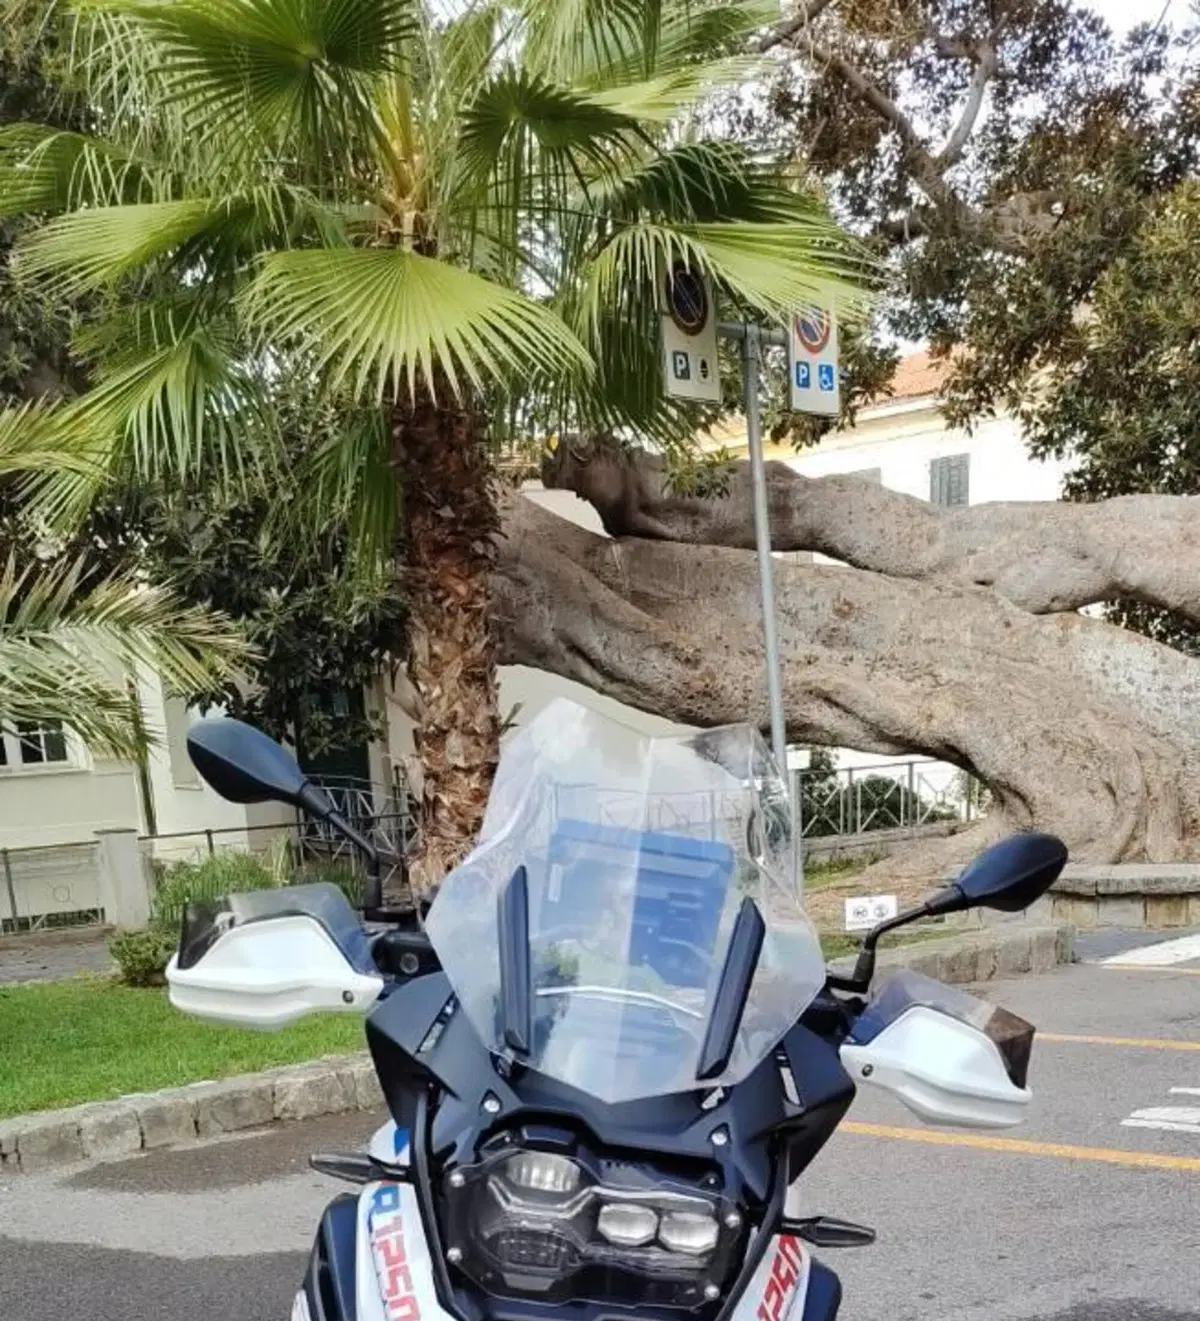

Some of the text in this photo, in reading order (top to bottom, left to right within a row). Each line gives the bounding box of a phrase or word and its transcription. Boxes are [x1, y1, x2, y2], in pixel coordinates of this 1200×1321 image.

[676, 354, 686, 378] P
[800, 365, 808, 386] P
[367, 1183, 400, 1234] R
